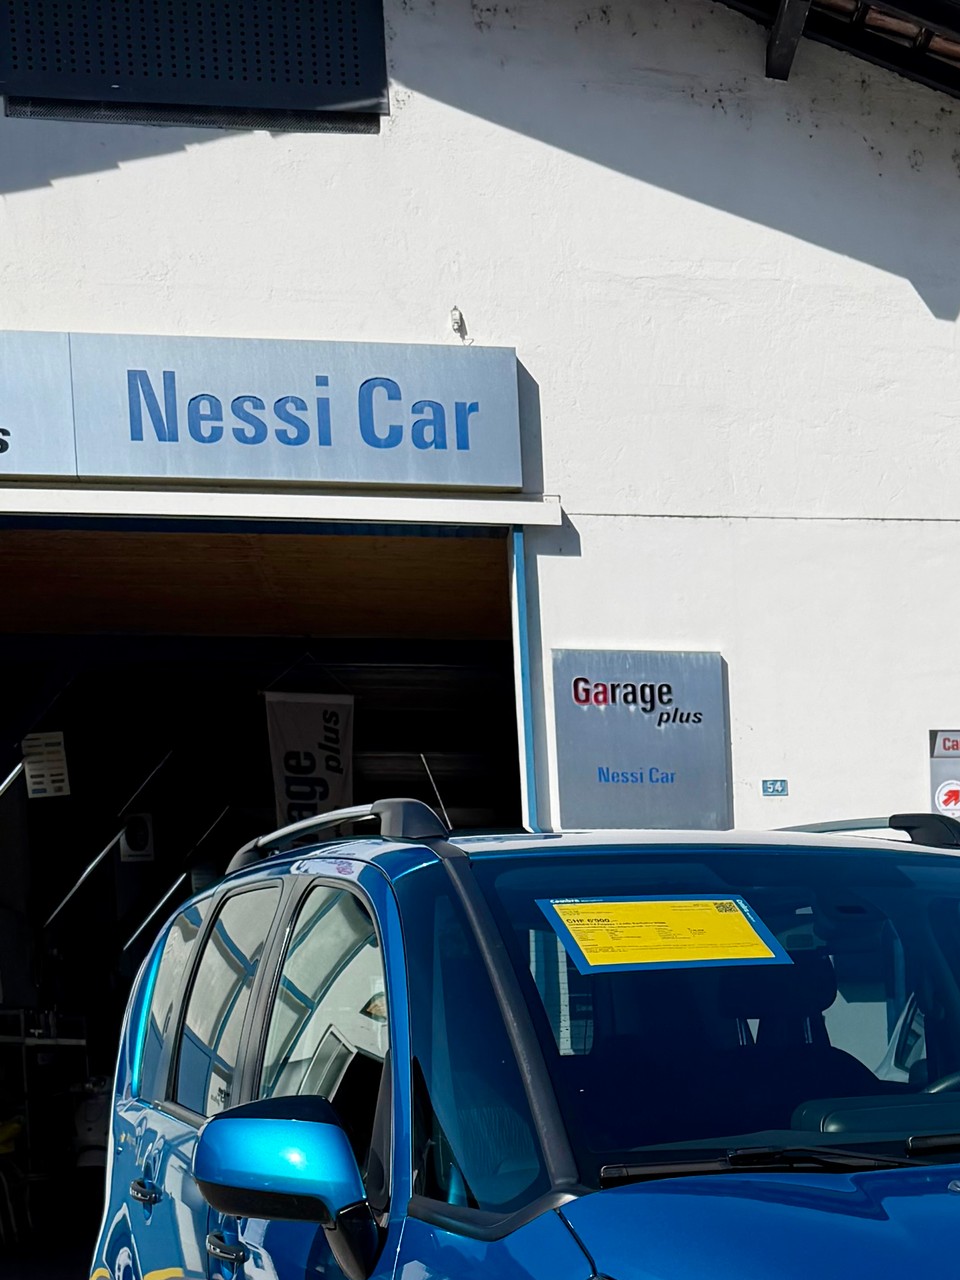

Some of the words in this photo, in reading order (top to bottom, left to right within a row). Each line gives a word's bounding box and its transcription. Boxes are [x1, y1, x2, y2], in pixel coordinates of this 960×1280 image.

[127, 369, 333, 447] Nessi
[358, 377, 479, 451] Car
[572, 676, 673, 713] Garage
[657, 708, 703, 727] plus
[318, 710, 344, 775] plus
[598, 767, 644, 784] Nessi
[649, 767, 676, 784] Car
[767, 783, 782, 793] 54
